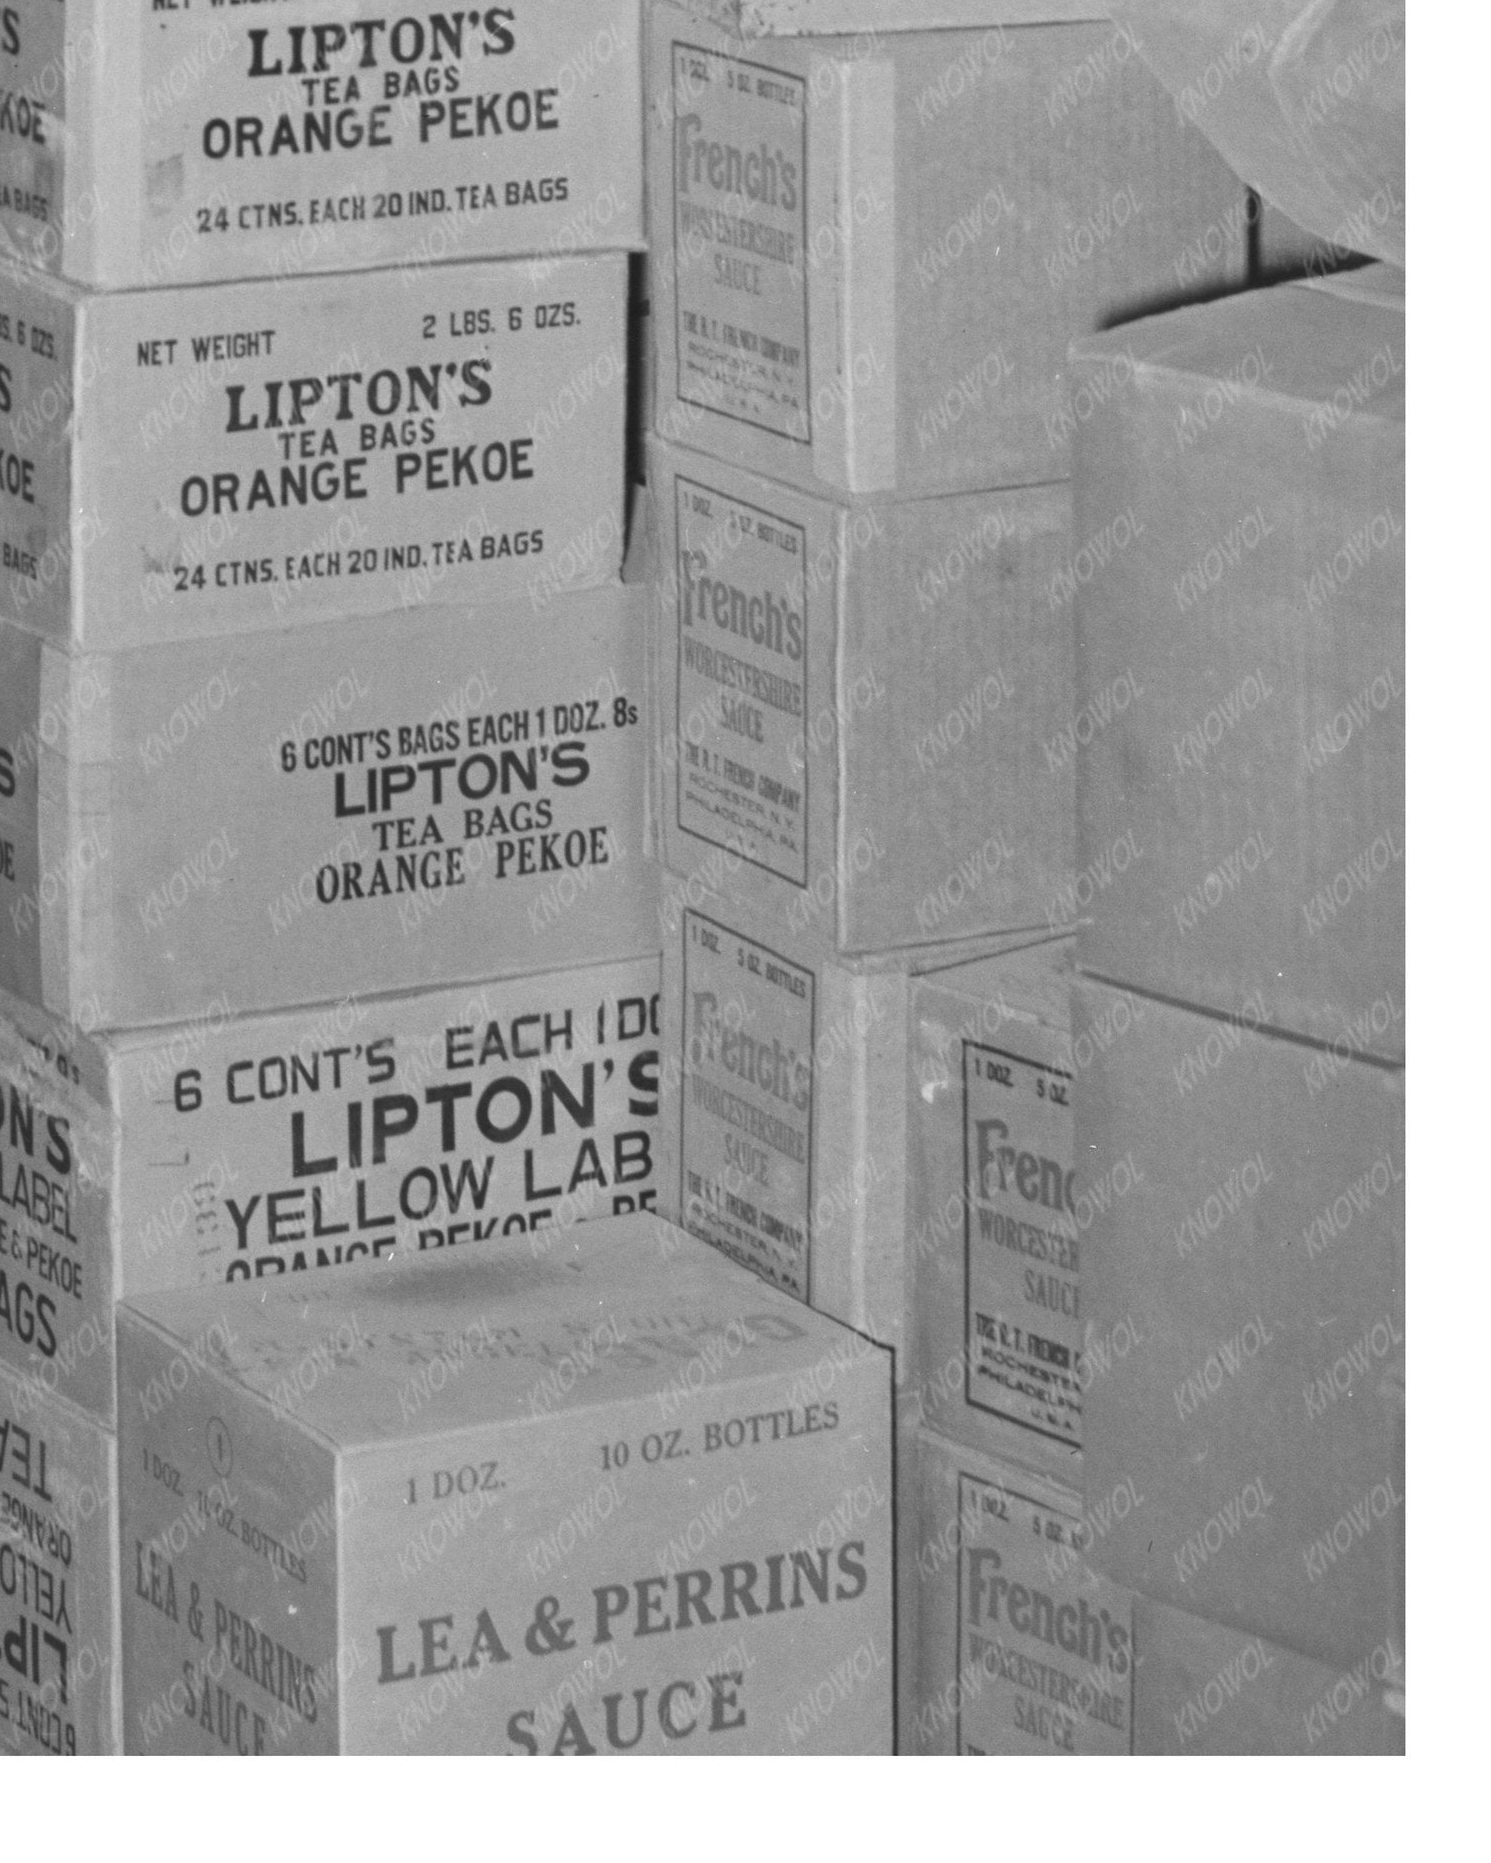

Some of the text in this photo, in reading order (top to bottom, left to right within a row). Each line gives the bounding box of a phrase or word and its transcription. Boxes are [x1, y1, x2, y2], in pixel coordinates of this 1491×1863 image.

[676, 111, 798, 214] French's
[679, 549, 805, 661] French's
[332, 741, 591, 818] LIPTON'S
[315, 823, 609, 908] ORANGE PEKOE
[405, 1400, 841, 1505] 1 DOZ. 10 OZ. BOTTLES
[376, 1539, 870, 1687] LEA & PERRINS
